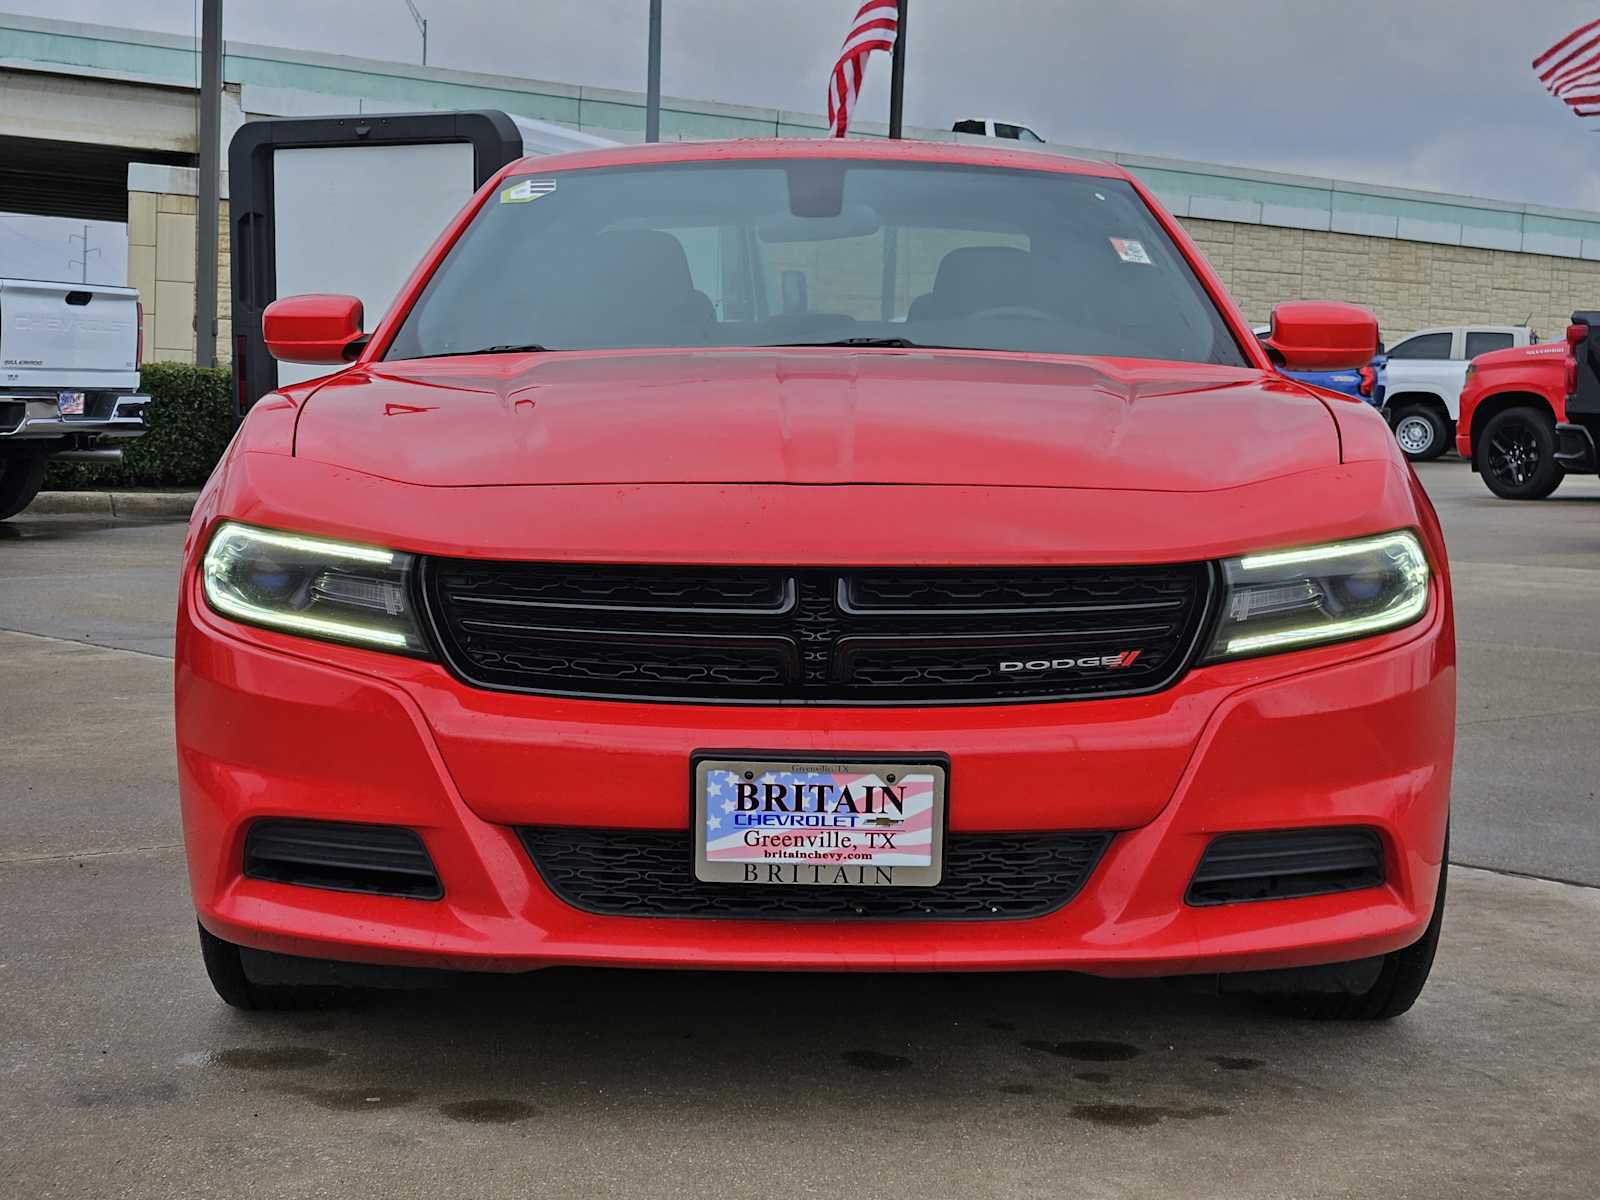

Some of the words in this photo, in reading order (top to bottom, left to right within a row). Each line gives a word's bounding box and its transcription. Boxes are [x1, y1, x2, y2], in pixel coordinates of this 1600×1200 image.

[1000, 655, 1123, 671] DODGE
[735, 783, 907, 815] BRITAIN
[734, 814, 860, 828] CHEVROLET
[744, 830, 857, 850] Greenville,
[865, 832, 897, 849] TX
[764, 850, 873, 861] britainchevy.com
[743, 863, 893, 884] BRITAIN
